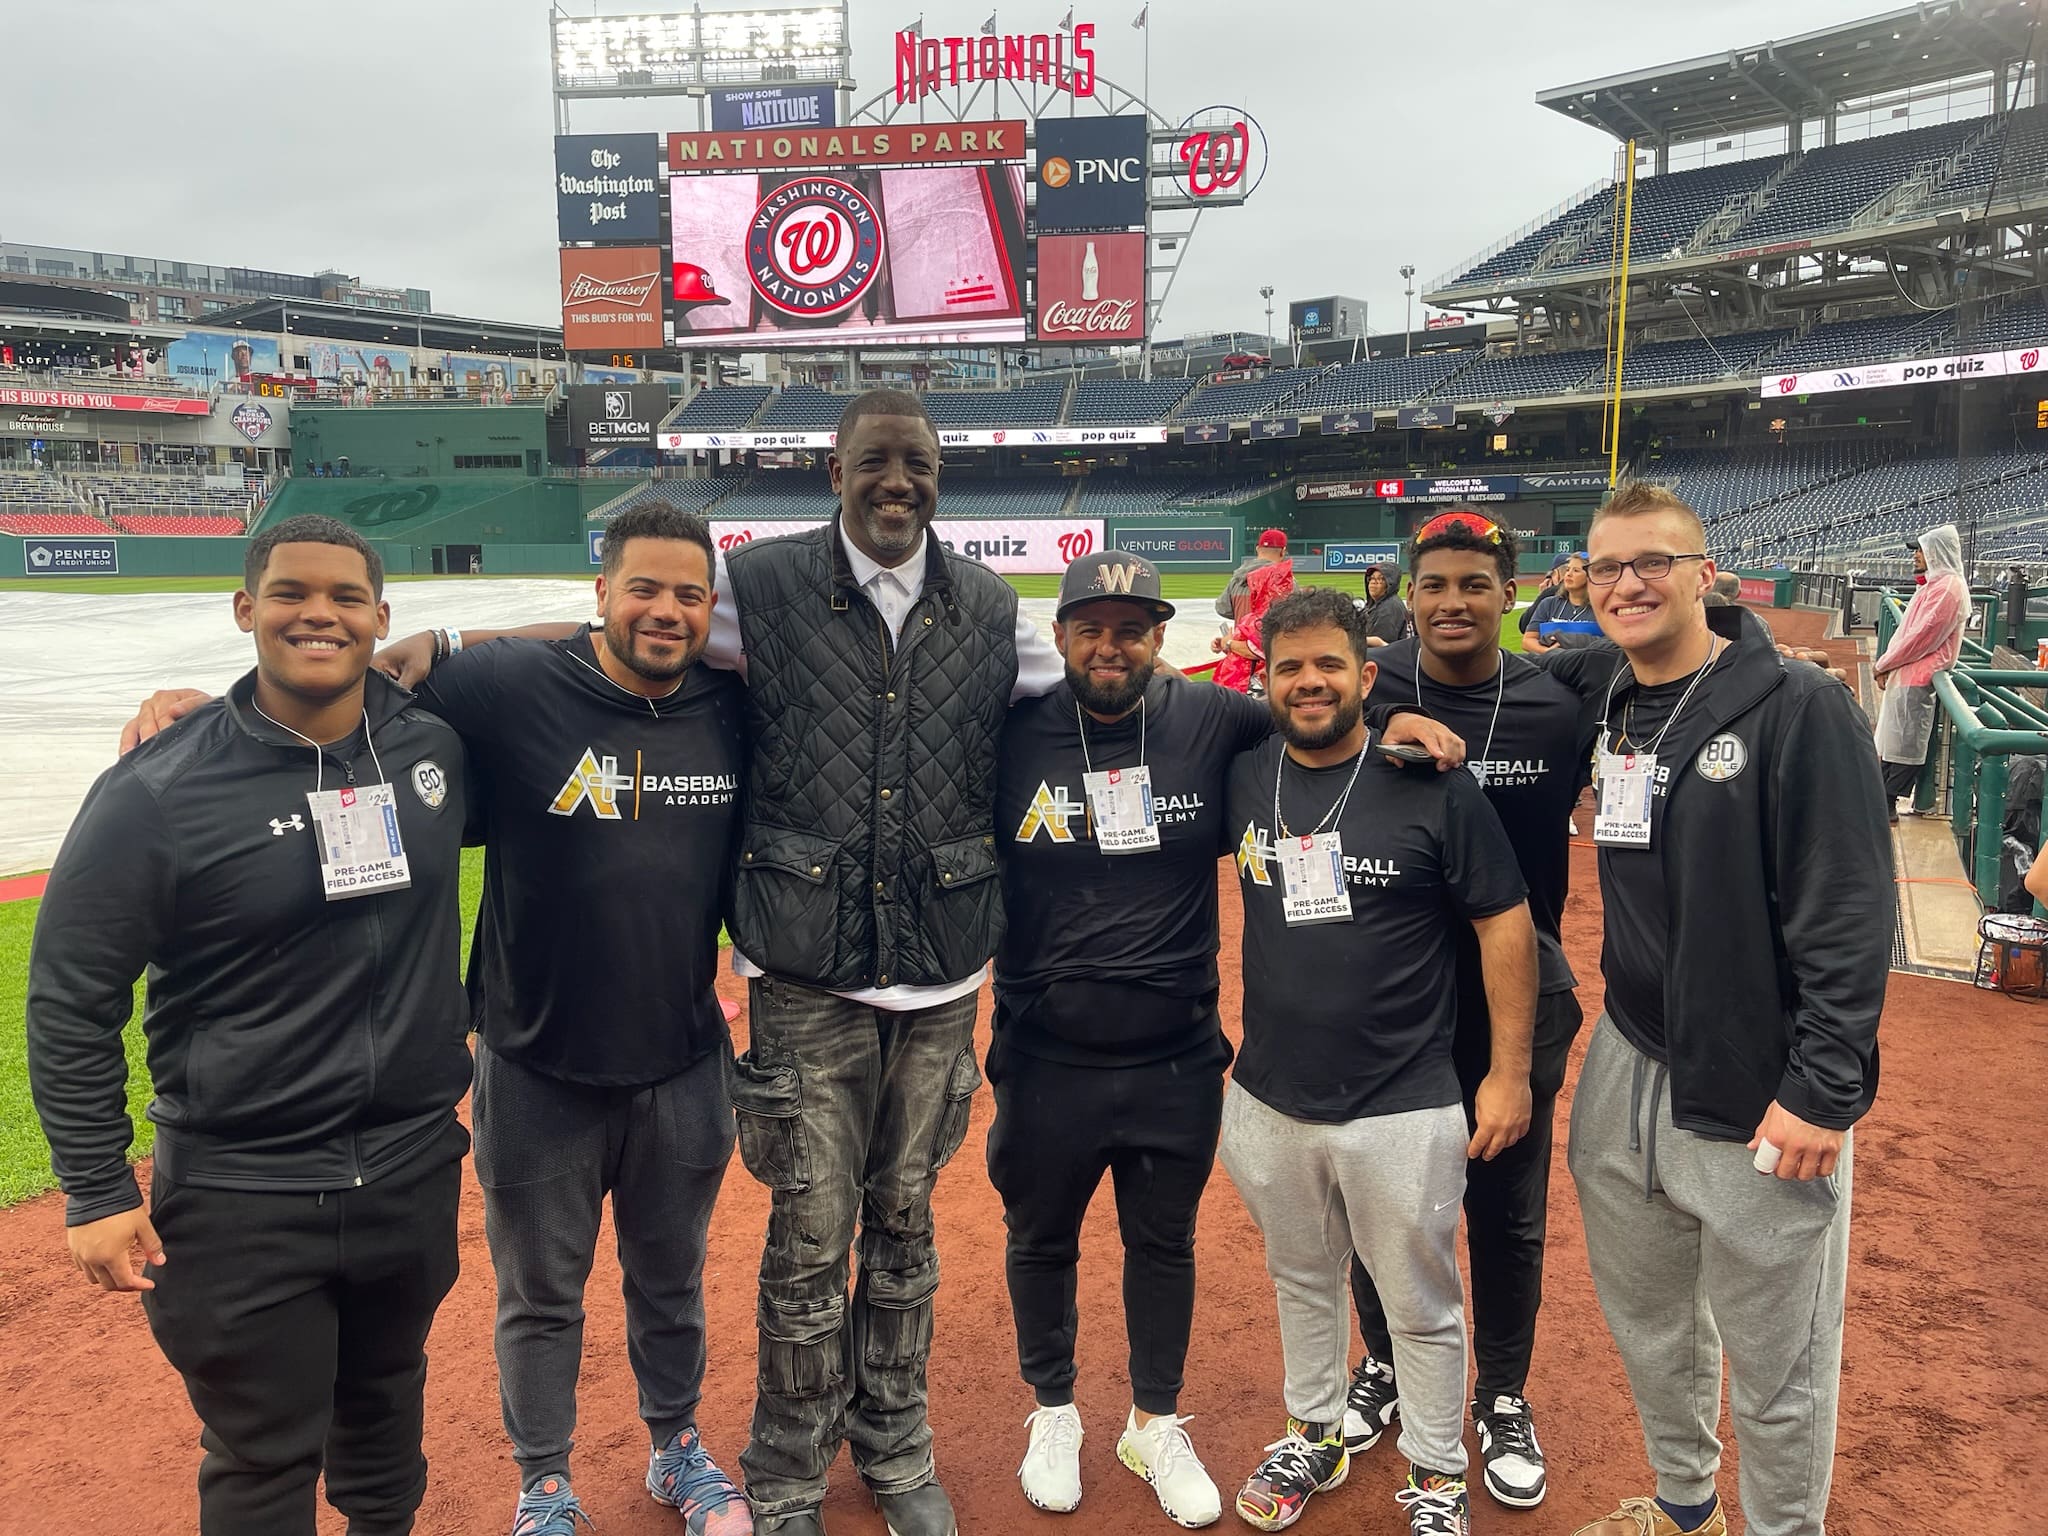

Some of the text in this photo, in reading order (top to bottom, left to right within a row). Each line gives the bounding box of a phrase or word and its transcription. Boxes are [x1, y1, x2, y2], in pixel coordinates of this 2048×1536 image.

[895, 23, 1095, 104] NATIONALS
[725, 88, 782, 102] SHOW SOME
[741, 95, 820, 126] NATITUDE
[680, 129, 1005, 161] NATIONALS PARK
[590, 149, 621, 170] The
[1075, 157, 1141, 183] PNC
[559, 172, 655, 198] Washington
[755, 183, 869, 229] WASHINGTON
[589, 201, 627, 225] Post
[570, 281, 649, 297] Budweiser
[758, 261, 869, 306] NATIONALS
[571, 312, 655, 324] THIS BUD'S FOR YOU.
[1043, 299, 1138, 332] Coca-Cola
[18, 355, 51, 366] LOFT
[1902, 358, 1985, 381] pop quiz
[260, 383, 284, 398] 0:15
[21, 391, 59, 405] BUD'S
[61, 393, 85, 406] FOR
[87, 395, 116, 408] YOU.
[9, 421, 65, 432] BREW HOUSE
[589, 421, 650, 434] BETMGM
[754, 436, 777, 446] pop
[780, 435, 806, 445] quiz
[942, 432, 969, 443] quiz
[1081, 431, 1107, 442] pop
[1109, 430, 1136, 440] quiz
[1434, 479, 1471, 487] WELCOME
[1546, 477, 1610, 486] AMTRAK
[1309, 483, 1351, 495] WASHINGTON
[1328, 487, 1363, 499] NATIONALS
[1381, 482, 1399, 495] 4:15
[1429, 484, 1489, 494] NATIONALS PARK
[1386, 496, 1415, 504] NATIONALS
[964, 535, 1027, 561] quiz
[1120, 540, 1225, 551] VENTURE GLOBAL
[1558, 541, 1570, 553] 335
[54, 549, 111, 560] PENFED
[1345, 553, 1396, 564] DABOS
[1707, 740, 1735, 762] 80
[1467, 759, 1550, 775] SEBALL
[642, 774, 738, 792] BASEBALL
[1484, 776, 1538, 787] ADEMY
[665, 793, 734, 806] ACADEMY
[1152, 792, 1204, 812] BALL
[1604, 821, 1643, 830] PRE-GAME
[1103, 828, 1147, 838] PRE-GAME
[1596, 829, 1648, 839] FIELD ACCESS
[1100, 835, 1156, 847] FIELD ACCESS
[334, 861, 392, 877] PRE-GAME
[1343, 856, 1401, 876] BALL
[327, 869, 405, 889] FIELD ACCESS
[1293, 896, 1339, 909] PRE-GAME
[1287, 904, 1348, 918] FIELD ACCESS
